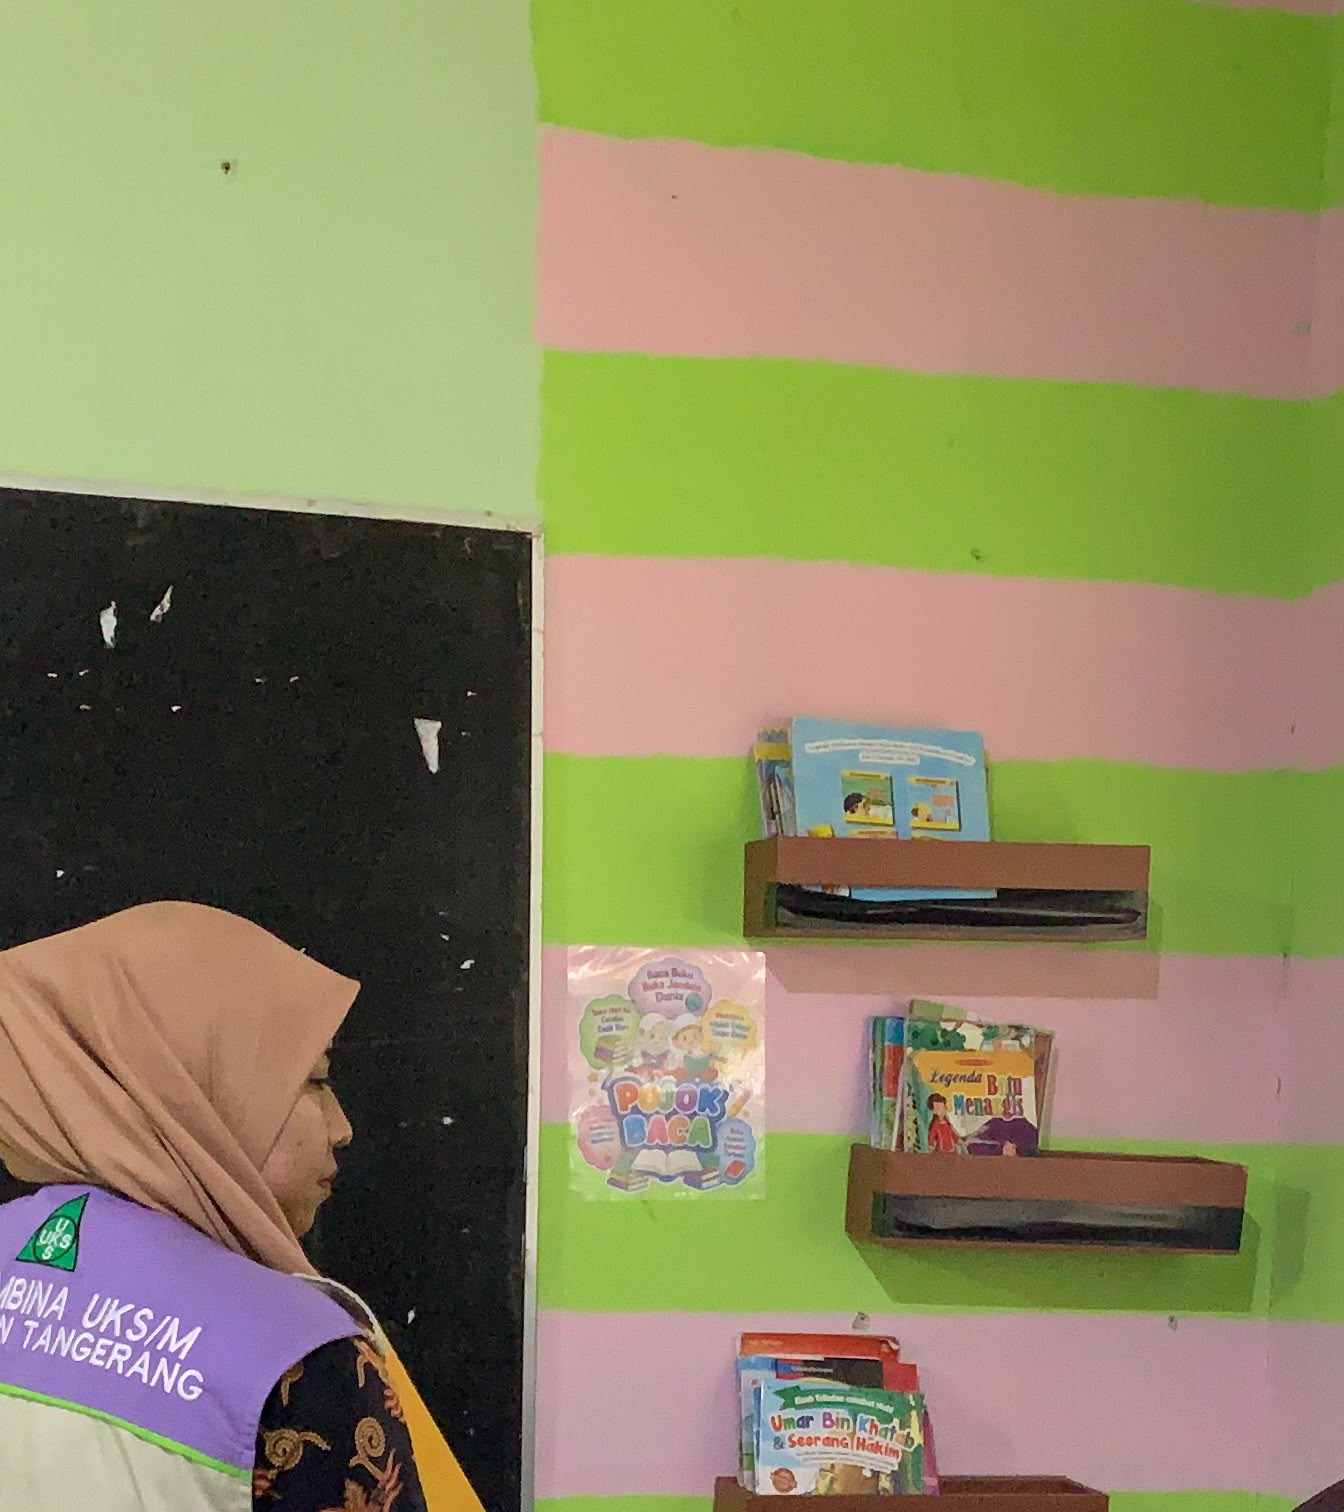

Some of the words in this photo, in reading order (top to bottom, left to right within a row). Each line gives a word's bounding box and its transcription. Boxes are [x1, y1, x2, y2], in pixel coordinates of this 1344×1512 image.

[930, 1069, 983, 1088] Legenda
[613, 1080, 724, 1115] POJOK
[623, 1114, 713, 1149] BACA
[38, 1228, 73, 1249] UKS
[81, 1292, 203, 1361] UKS/M
[22, 1319, 205, 1402] TANGERANG
[770, 1414, 815, 1432] Umar
[821, 1411, 852, 1431] Bin
[772, 1435, 785, 1451] &
[856, 1436, 901, 1460] Hakim
